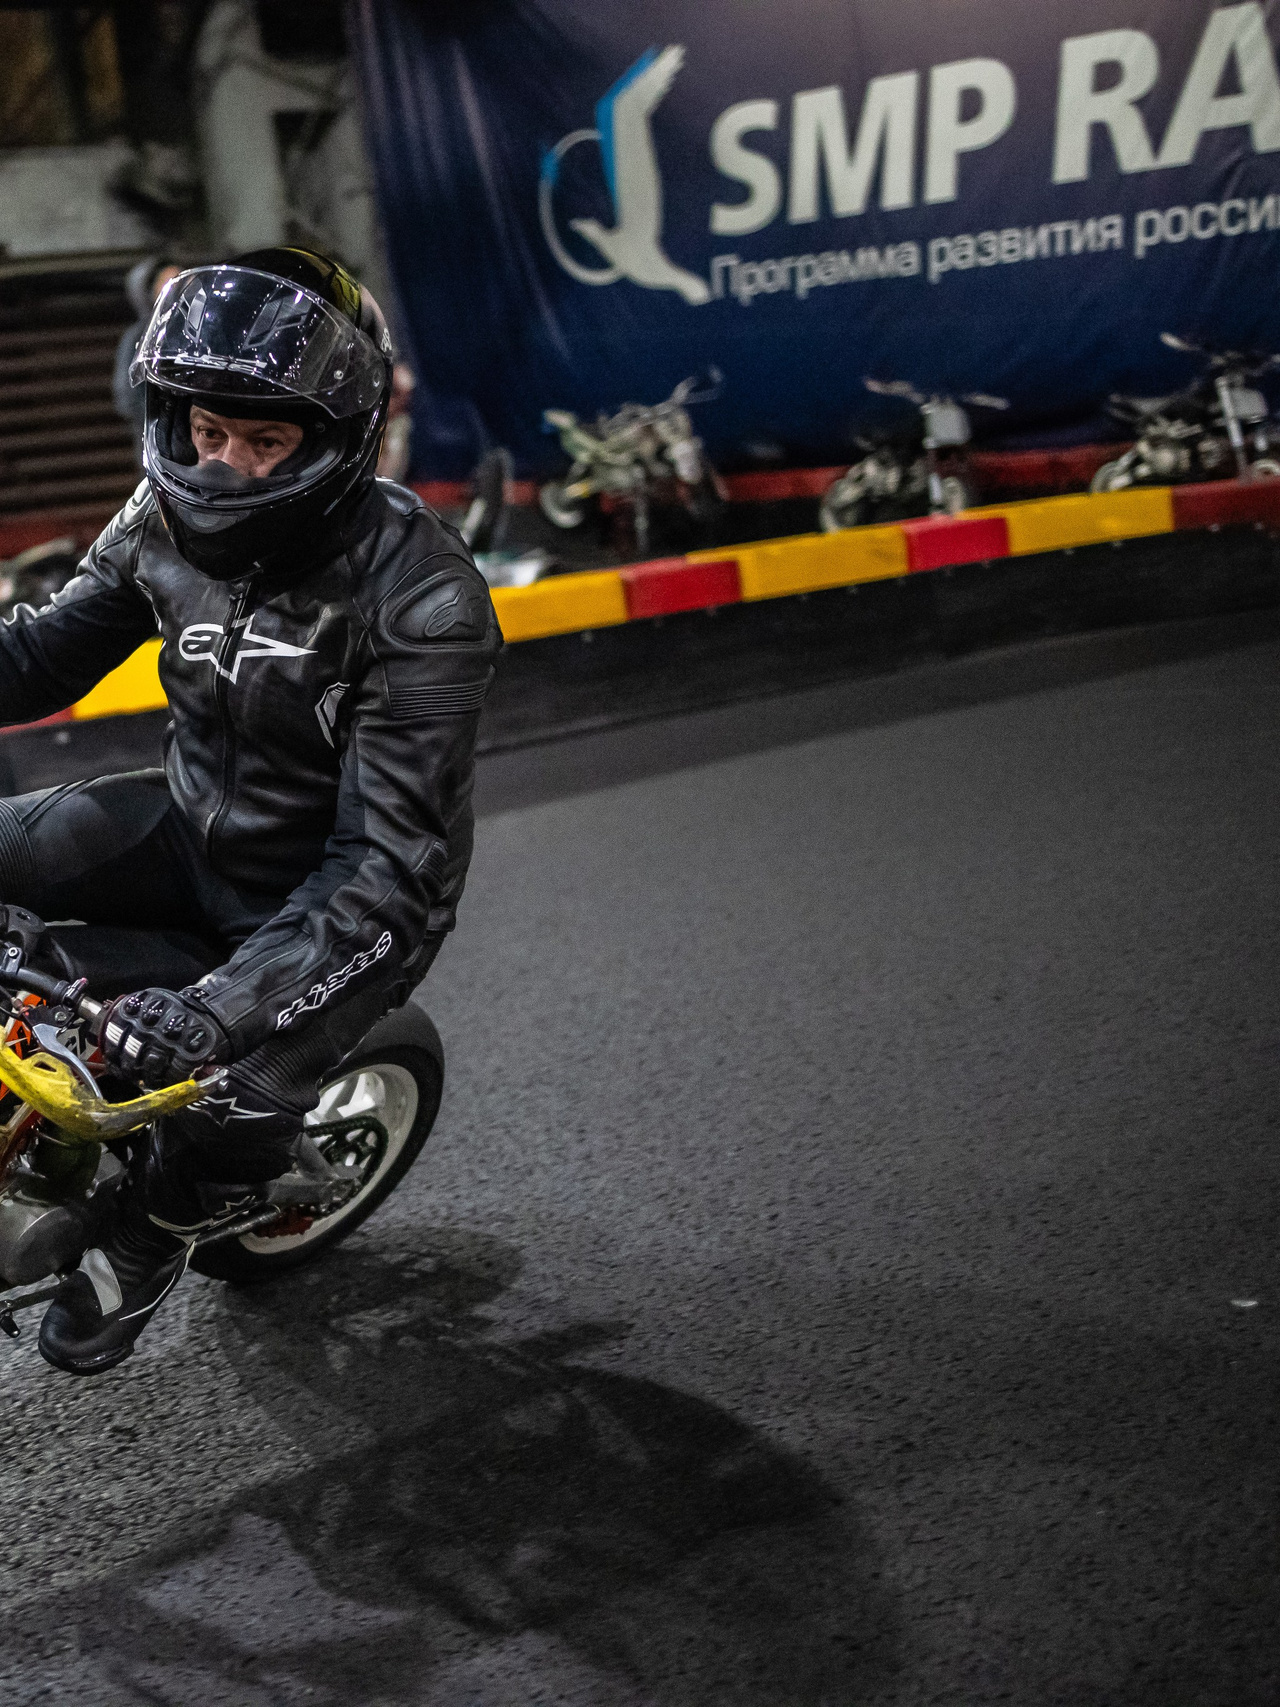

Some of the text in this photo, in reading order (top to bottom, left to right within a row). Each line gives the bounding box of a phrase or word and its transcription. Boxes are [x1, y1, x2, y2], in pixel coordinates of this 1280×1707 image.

[710, 2, 1280, 236] SMP RA
[711, 240, 920, 306] Программа
[927, 214, 1123, 285] развития
